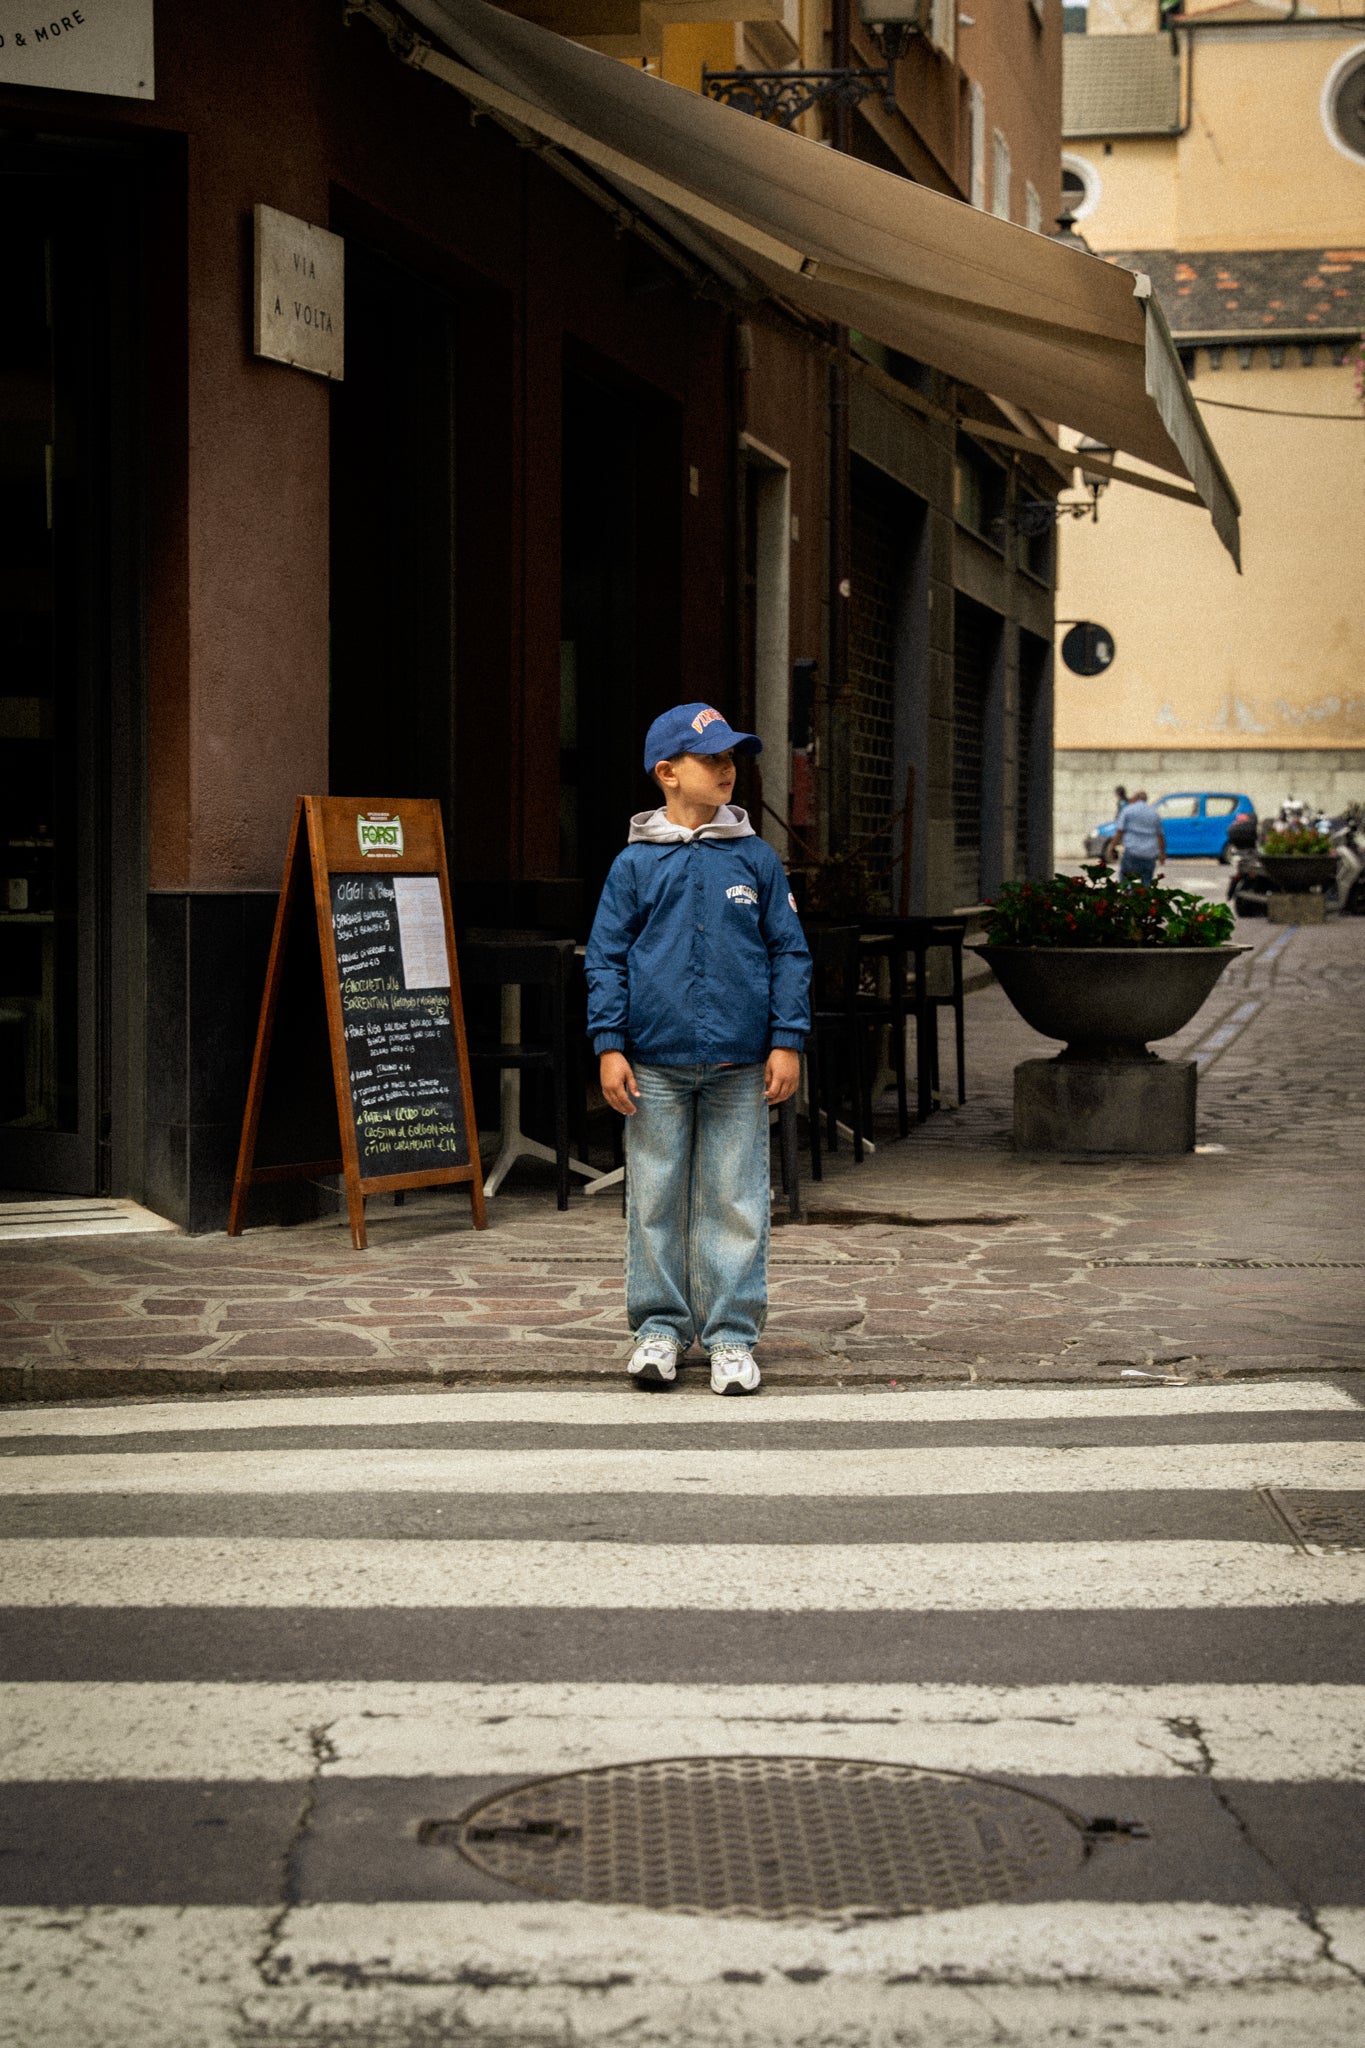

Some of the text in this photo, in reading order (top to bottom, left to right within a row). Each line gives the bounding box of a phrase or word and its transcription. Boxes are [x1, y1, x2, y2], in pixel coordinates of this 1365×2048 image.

[15, 33, 27, 46] &
[35, 9, 86, 43] MORE
[293, 253, 316, 279] VIA
[295, 302, 333, 332] VOLTA
[361, 825, 399, 845] FORST
[337, 882, 364, 901] OGGI
